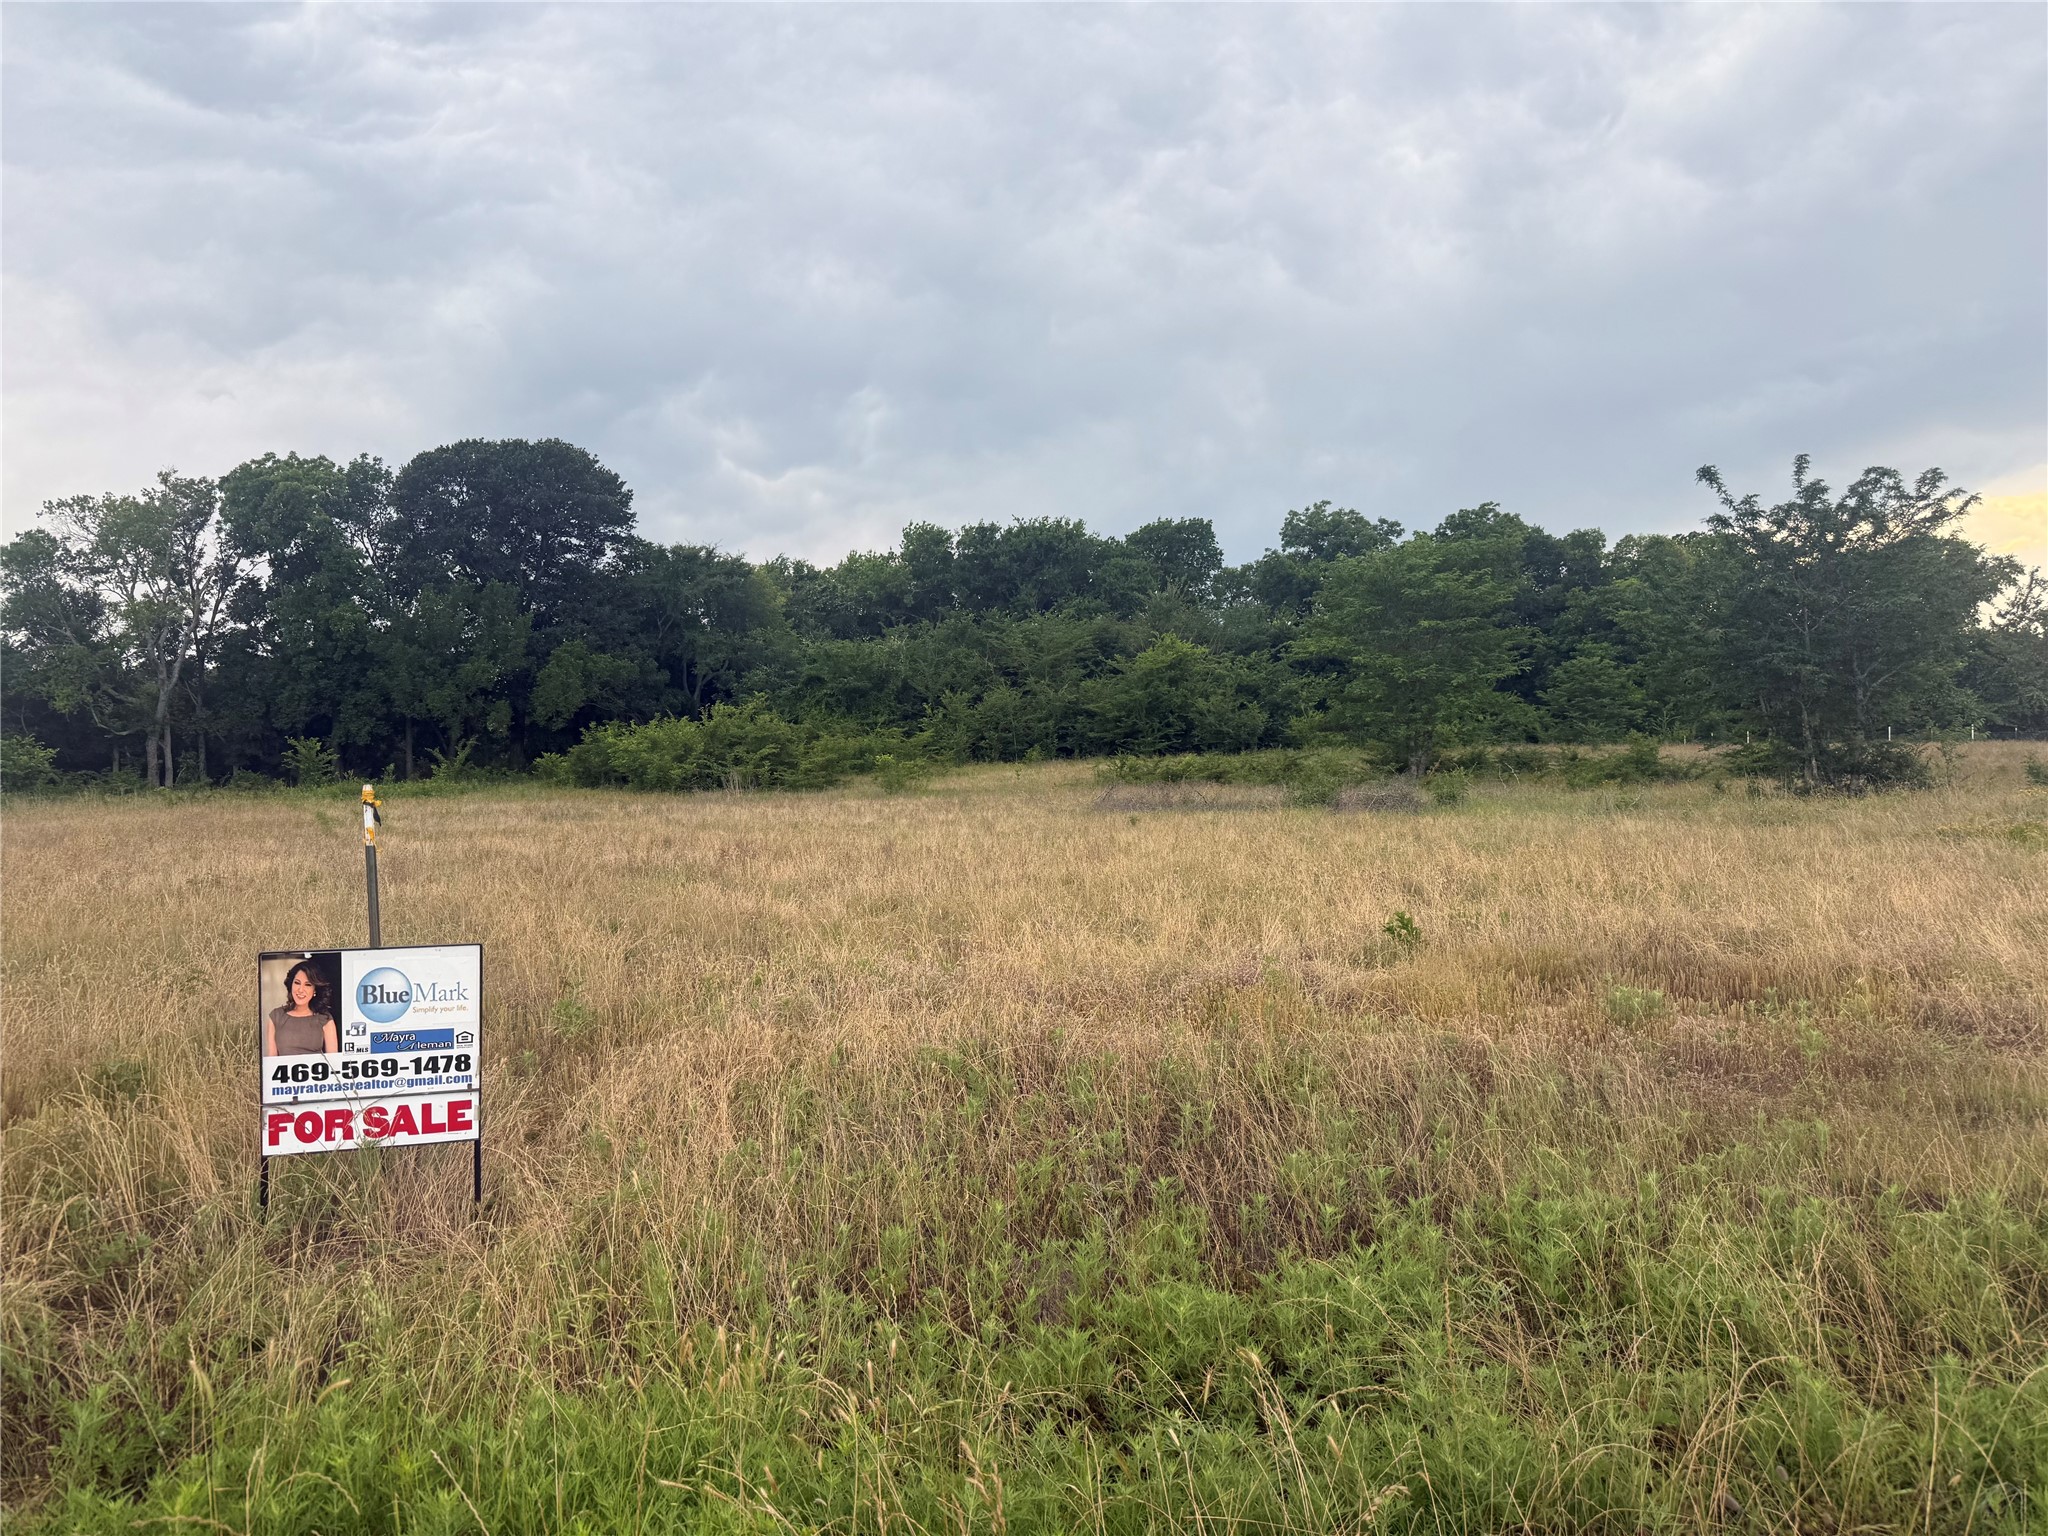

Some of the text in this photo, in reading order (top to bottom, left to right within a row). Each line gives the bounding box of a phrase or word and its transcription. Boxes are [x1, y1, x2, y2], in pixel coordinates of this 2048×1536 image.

[361, 981, 469, 1005] Blue Mark
[412, 1004, 469, 1014] Simplify your life.
[373, 1032, 416, 1044] Mayra
[396, 1040, 452, 1051] Aleman
[271, 1053, 471, 1084] 469-569-1478
[271, 1074, 473, 1096] mayratexasrealtor@gmail.com
[268, 1099, 473, 1147] FOR SALE
